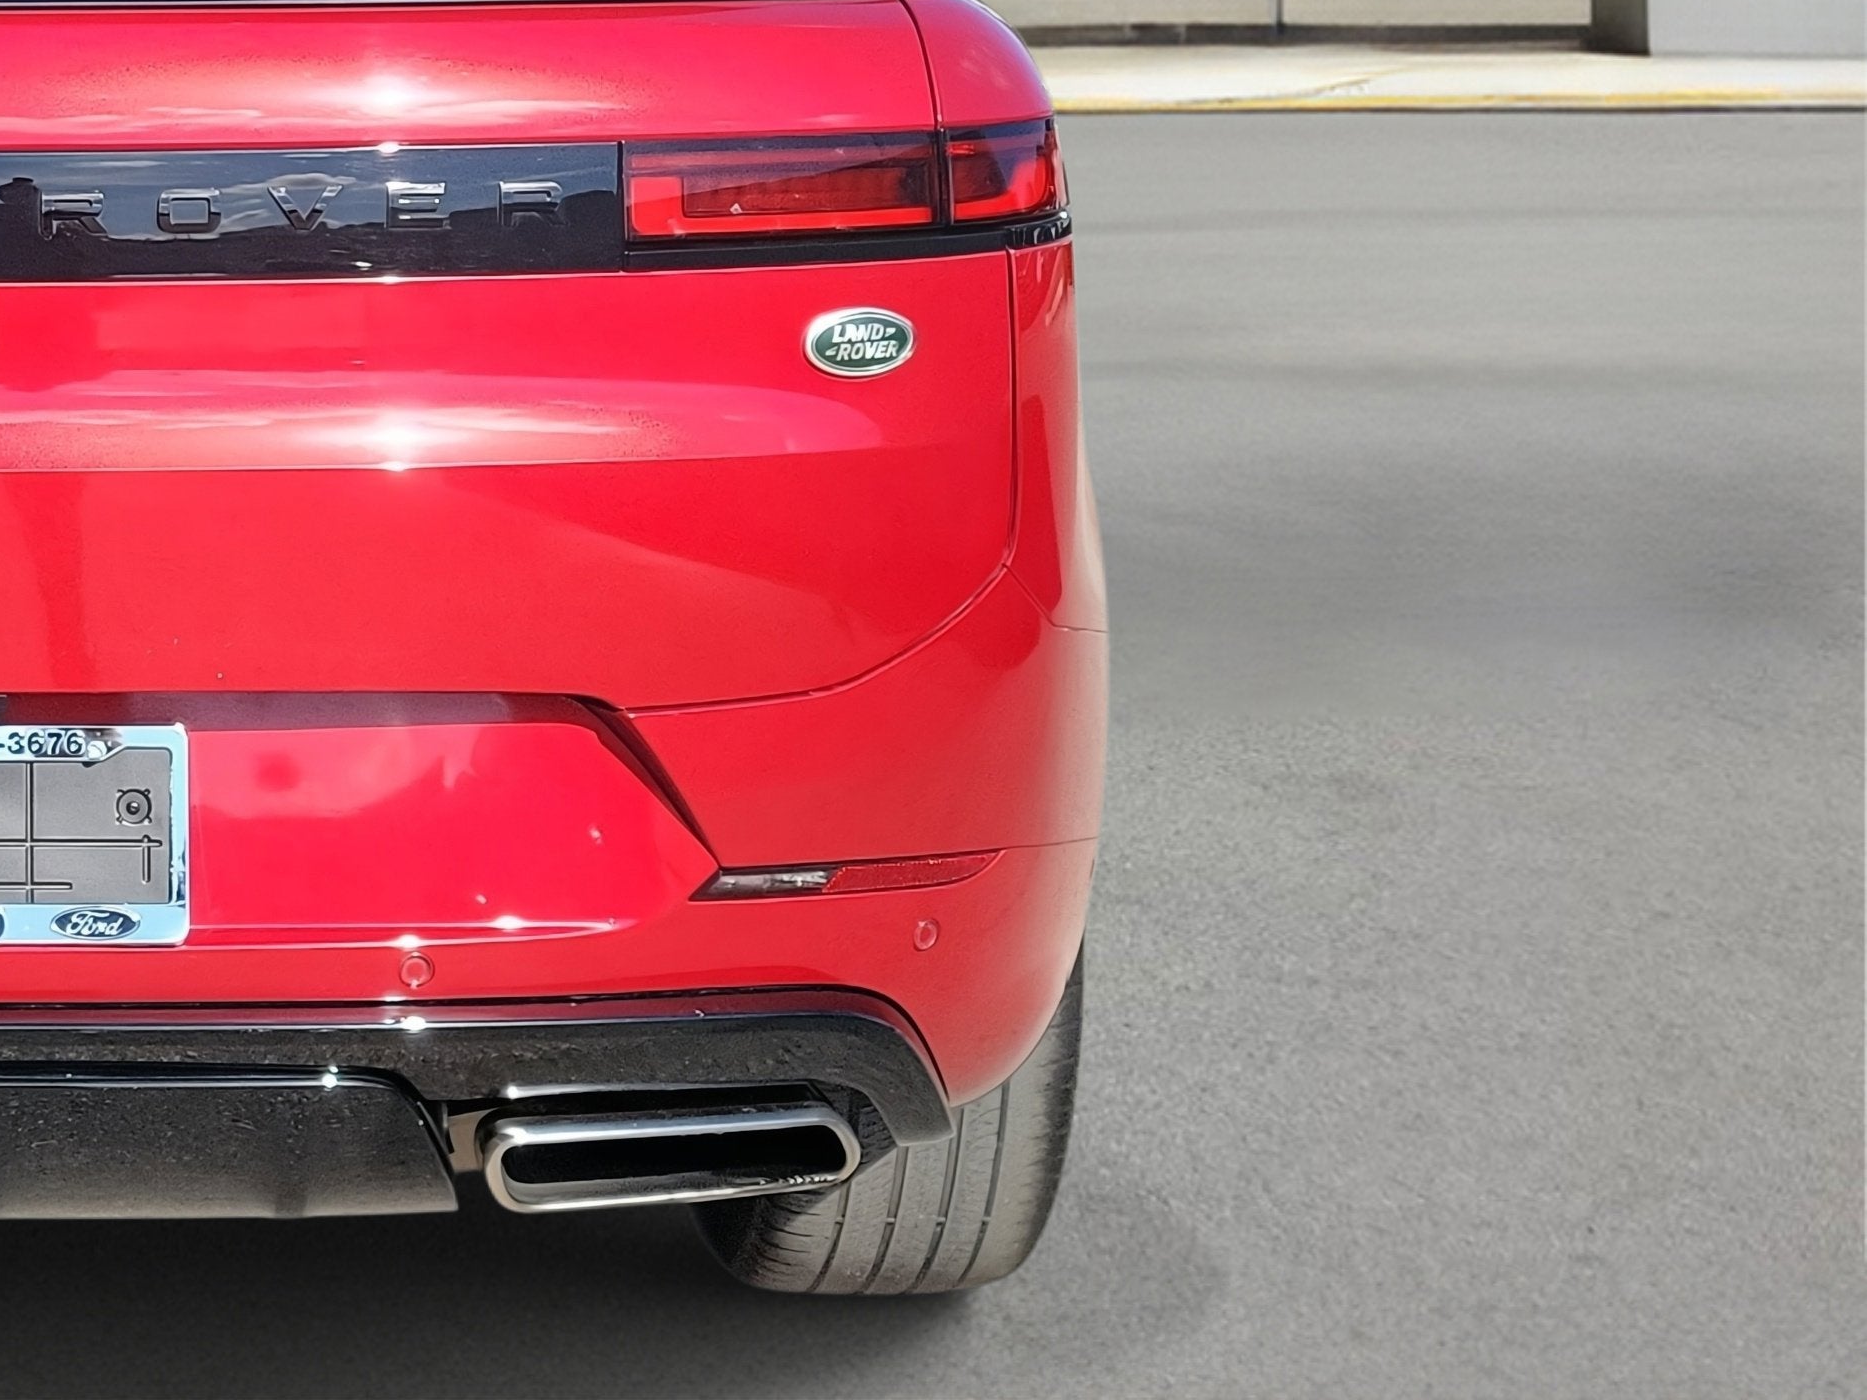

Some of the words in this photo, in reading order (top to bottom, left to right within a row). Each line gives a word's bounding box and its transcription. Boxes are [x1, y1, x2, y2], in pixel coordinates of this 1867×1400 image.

[38, 180, 570, 242] ROVER
[831, 323, 884, 343] LAND
[836, 340, 899, 361] ROVER
[65, 910, 124, 936] Ford
